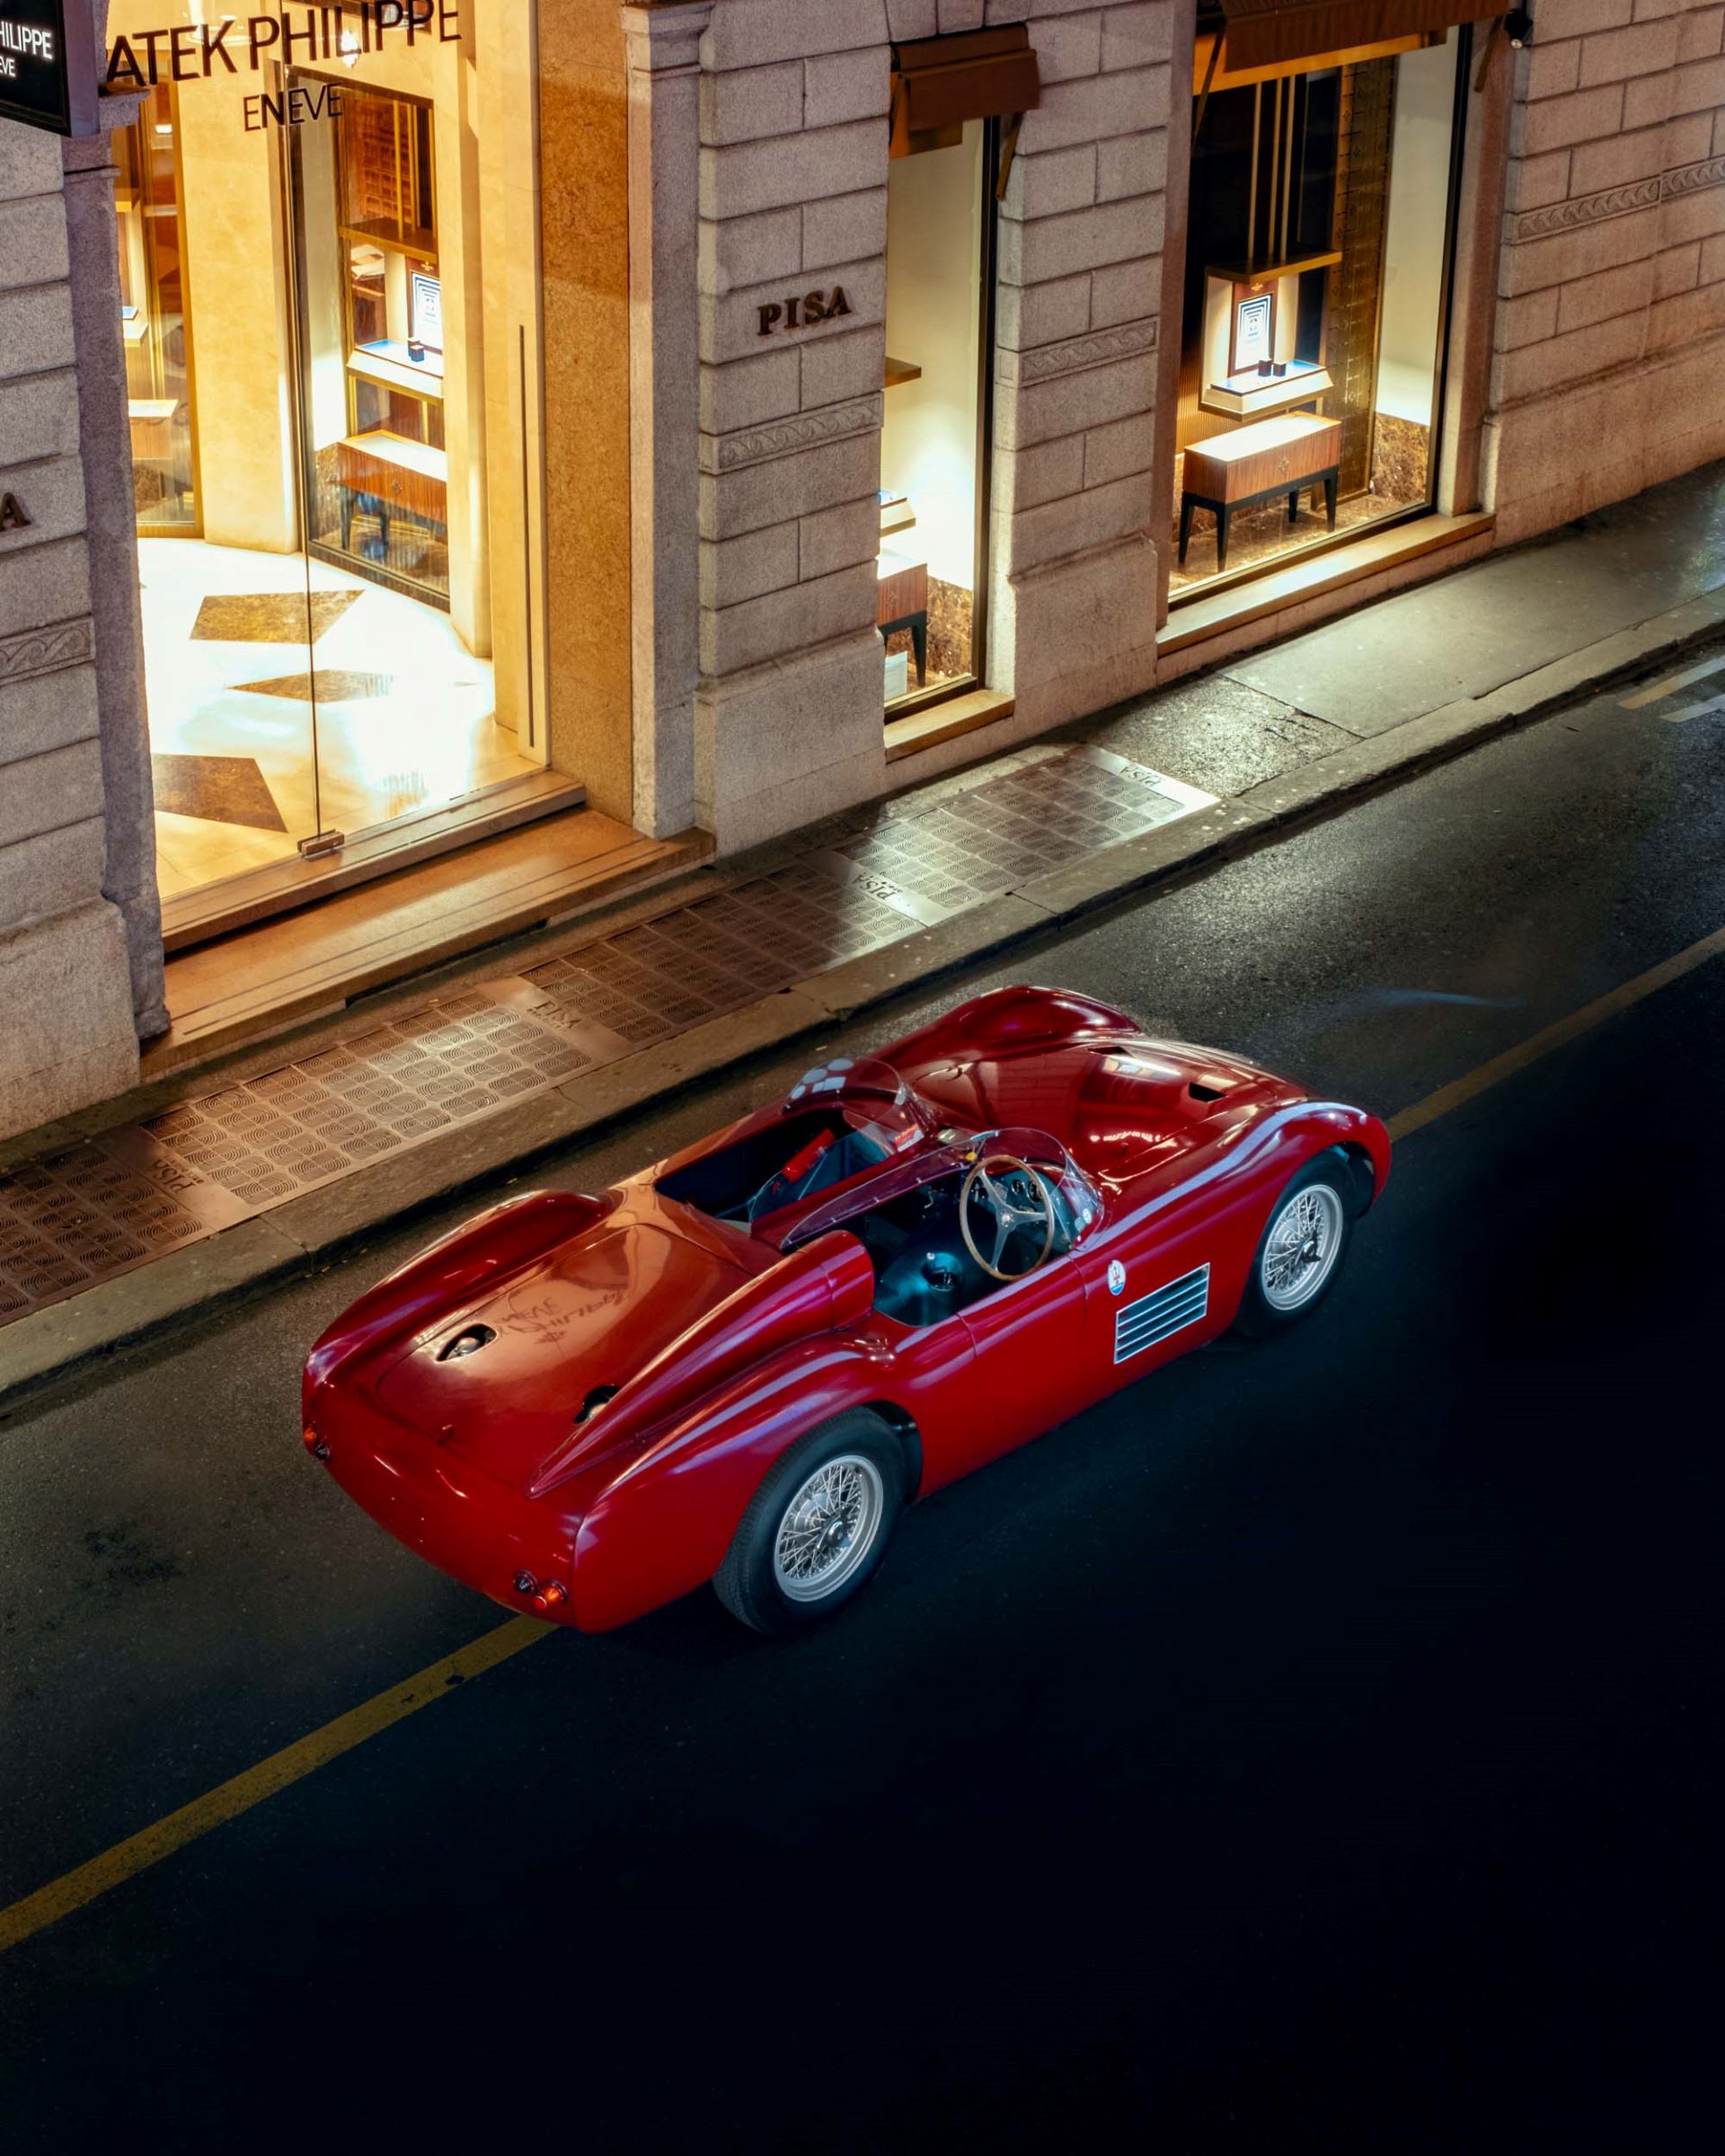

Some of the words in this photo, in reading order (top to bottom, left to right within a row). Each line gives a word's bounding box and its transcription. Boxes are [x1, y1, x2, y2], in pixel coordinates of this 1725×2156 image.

[107, 20, 237, 87] ATEK
[248, 0, 462, 70] PHILIPPE
[243, 83, 343, 132] ENEVE
[757, 287, 852, 336] PISA
[0, 492, 31, 532] A
[1119, 766, 1162, 787] PISA
[850, 874, 896, 900] PISA
[533, 1000, 582, 1030] PISA
[146, 1159, 196, 1193] PISA
